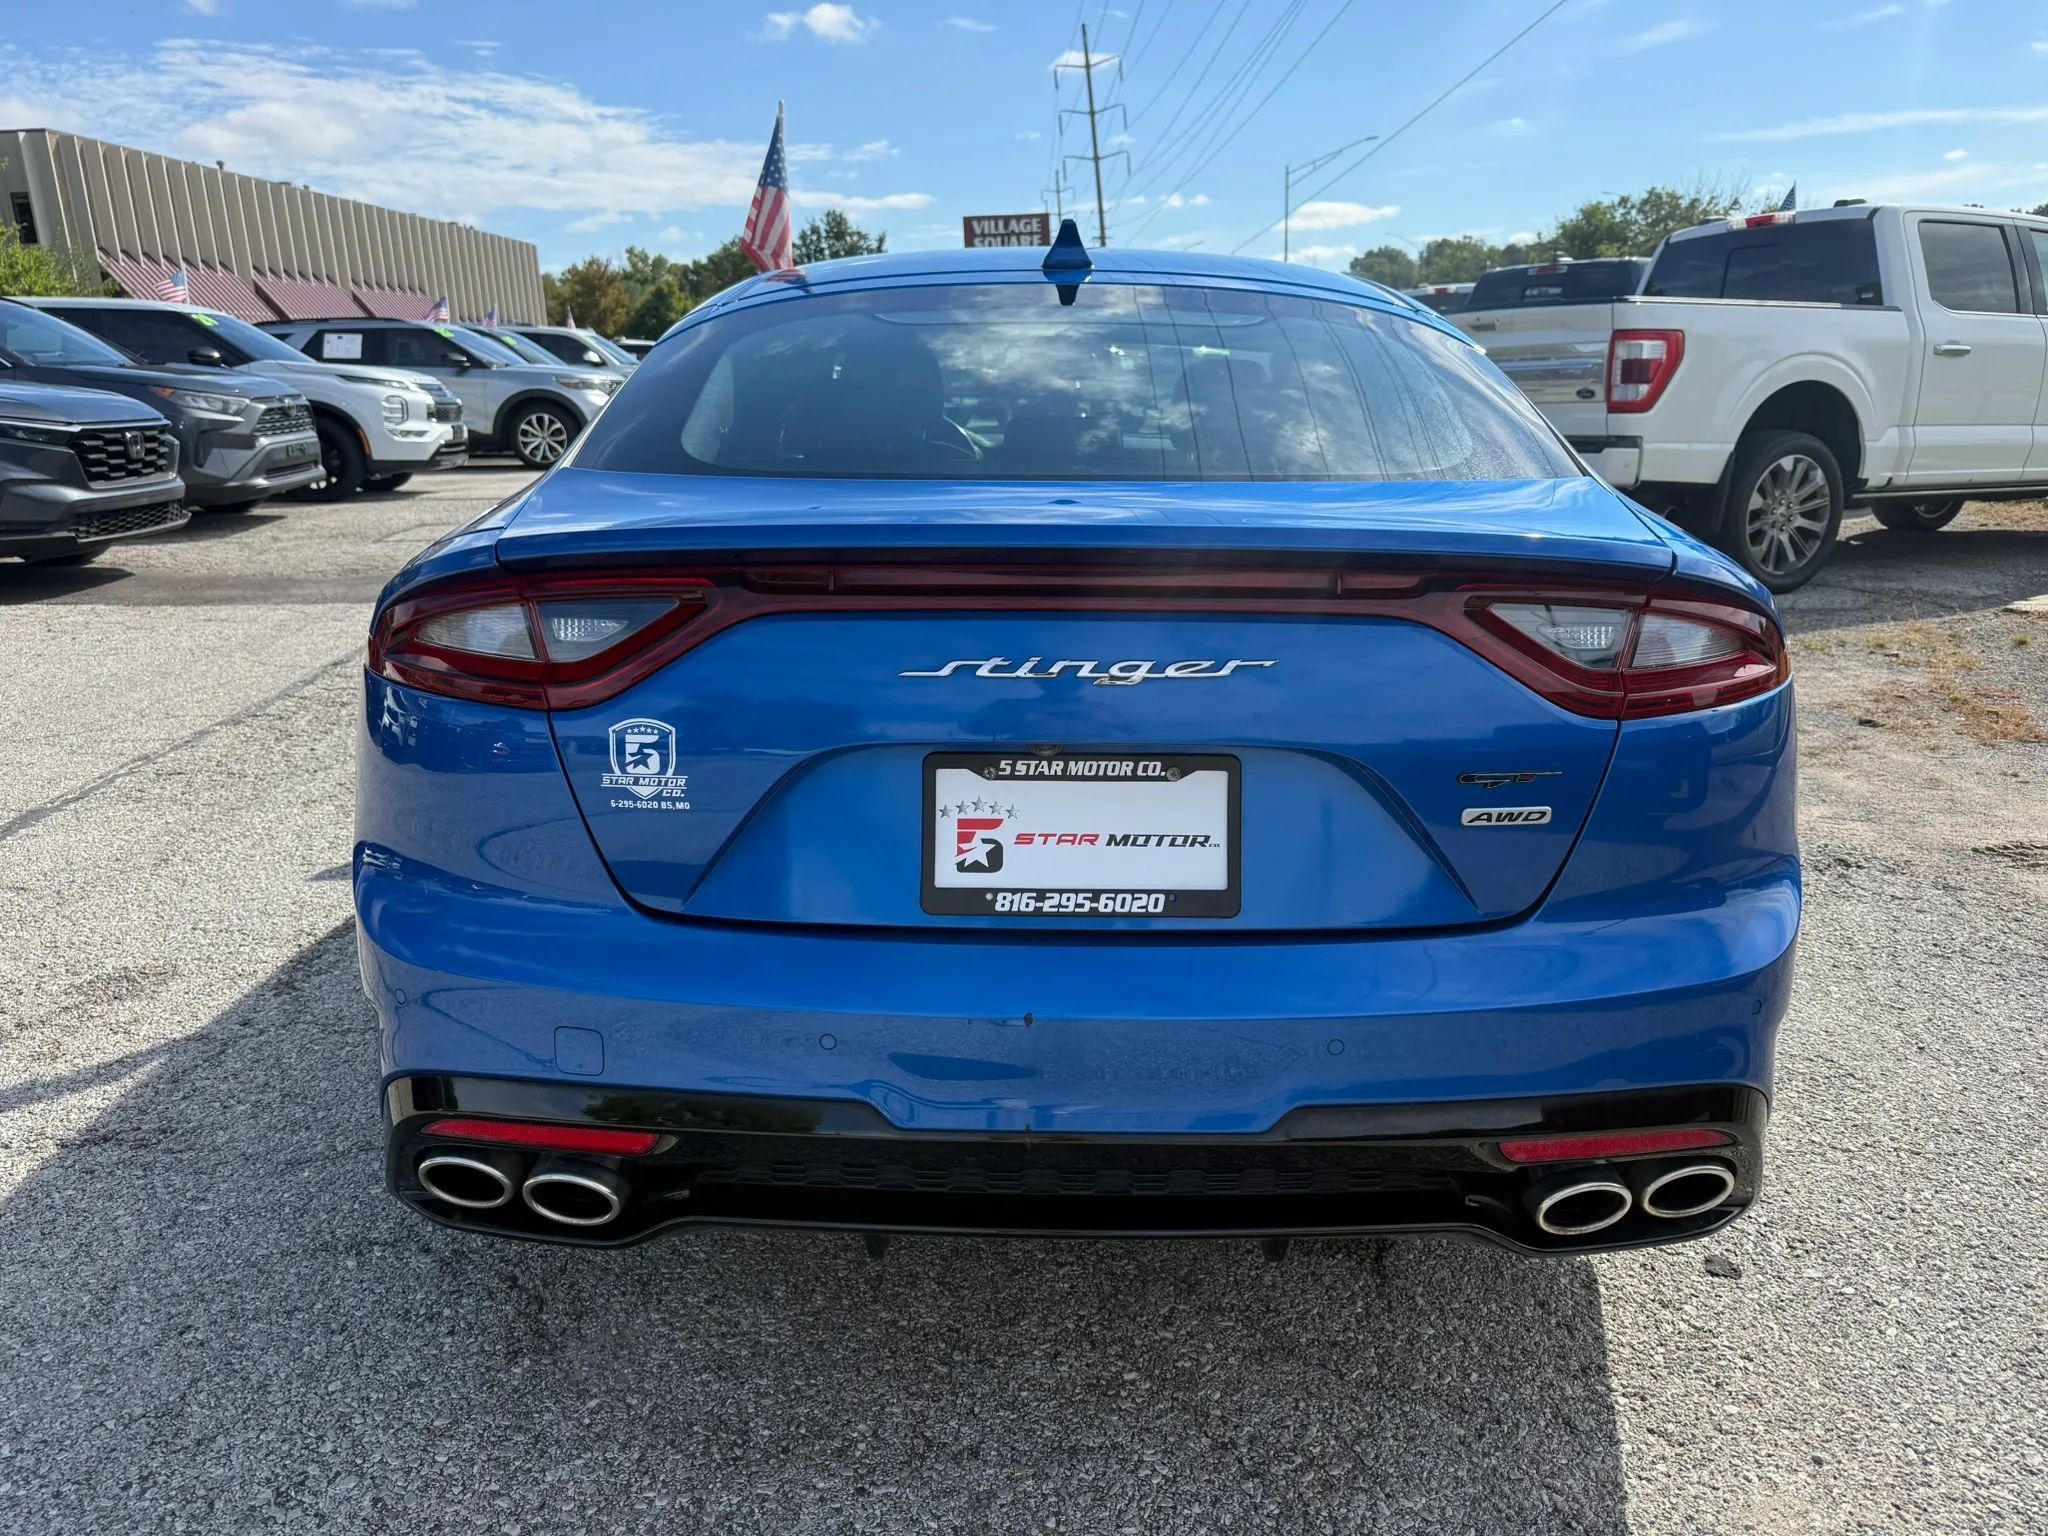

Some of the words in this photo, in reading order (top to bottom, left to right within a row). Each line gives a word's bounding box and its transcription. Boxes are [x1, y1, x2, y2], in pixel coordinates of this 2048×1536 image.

[971, 218, 1042, 235] VILLAGE
[899, 656, 1280, 686] stinger
[998, 760, 1012, 775] 5
[1014, 760, 1064, 776] STAR
[1066, 761, 1134, 776] MOTOR
[1136, 761, 1166, 776] CO.
[602, 776, 634, 785] STAR
[638, 777, 686, 787] MOTOR
[662, 789, 685, 797] CO.
[1466, 811, 1548, 824] AWD
[1014, 833, 1100, 846] STAR
[1105, 833, 1211, 848] MOTOR
[994, 892, 1166, 913] 816-295-6020
